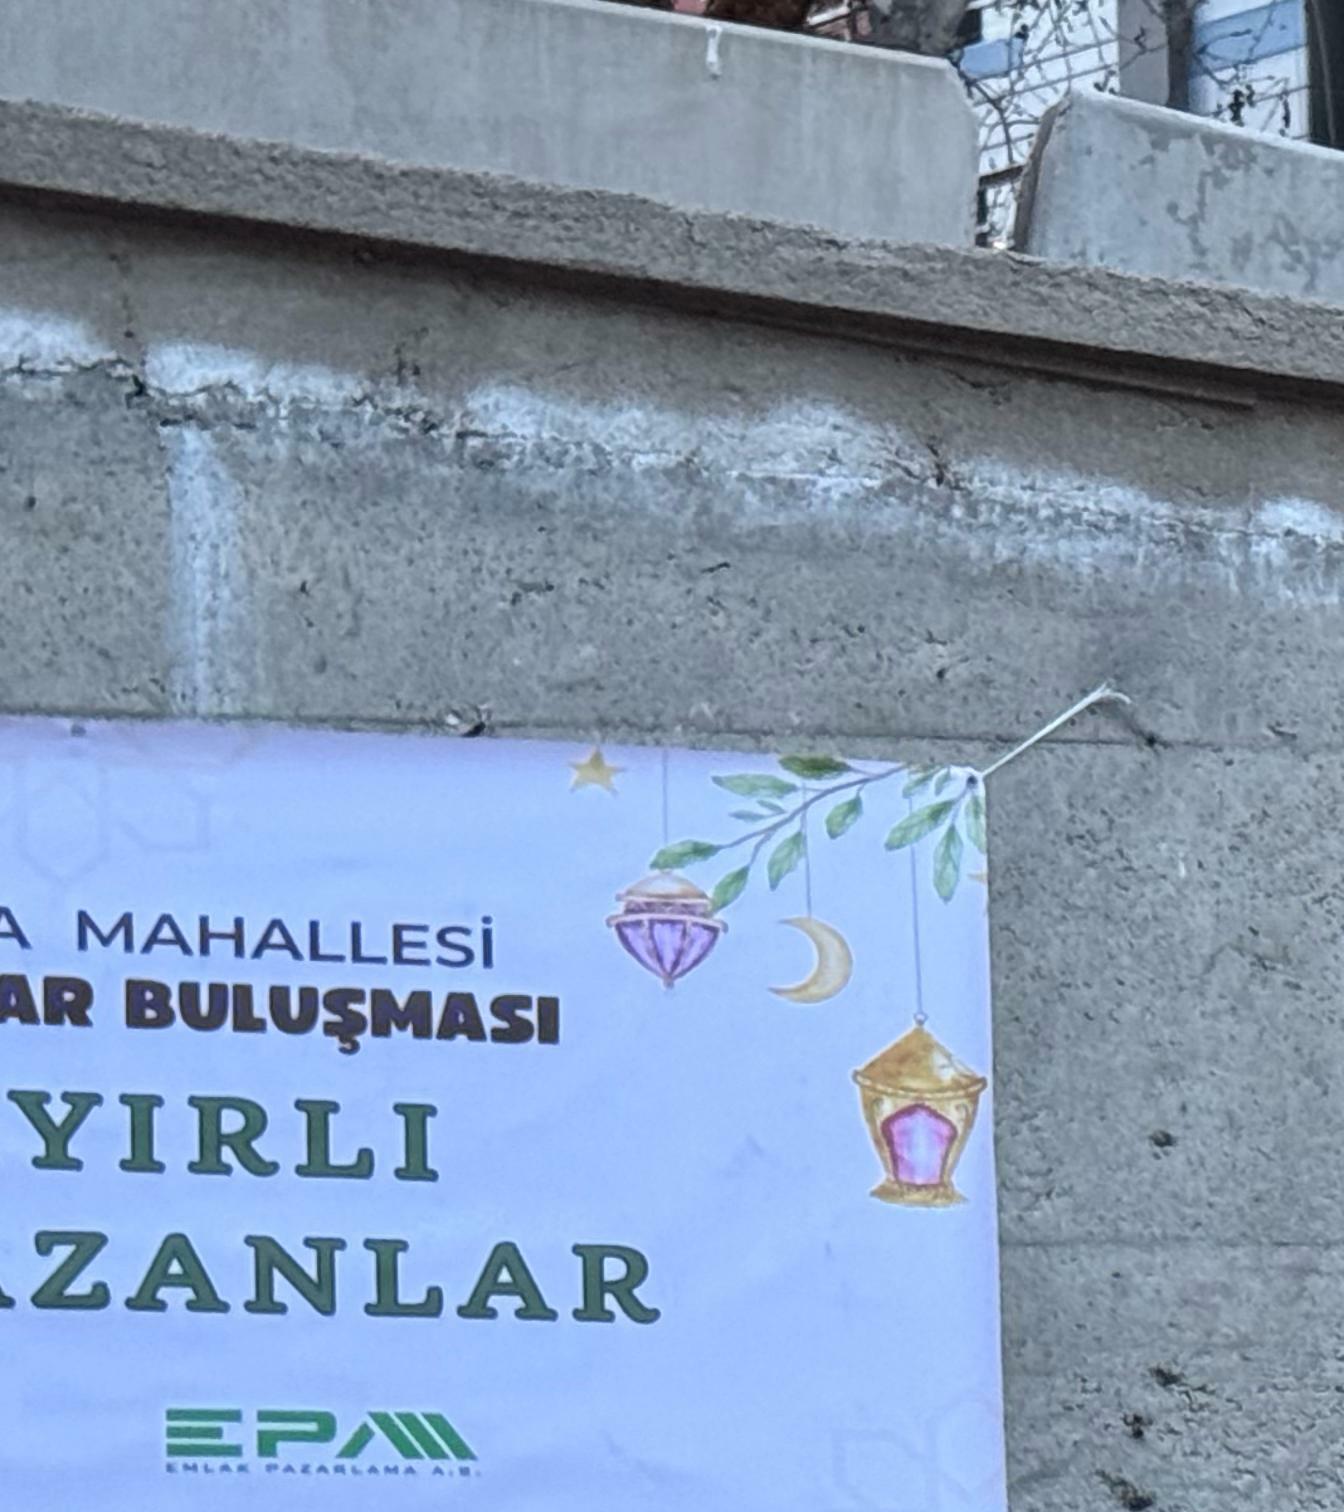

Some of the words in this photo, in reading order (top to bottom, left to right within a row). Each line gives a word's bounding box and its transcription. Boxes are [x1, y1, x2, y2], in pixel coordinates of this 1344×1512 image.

[77, 909, 494, 969] MAHALLESİ
[0, 973, 94, 1027] AR
[124, 978, 560, 1055] BULUŞMASI
[6, 1089, 440, 1183] YIRLI
[0, 1230, 661, 1325] ZANLAR
[165, 1463, 249, 1474] EMLAK
[265, 1463, 417, 1476] PAZARLAMA
